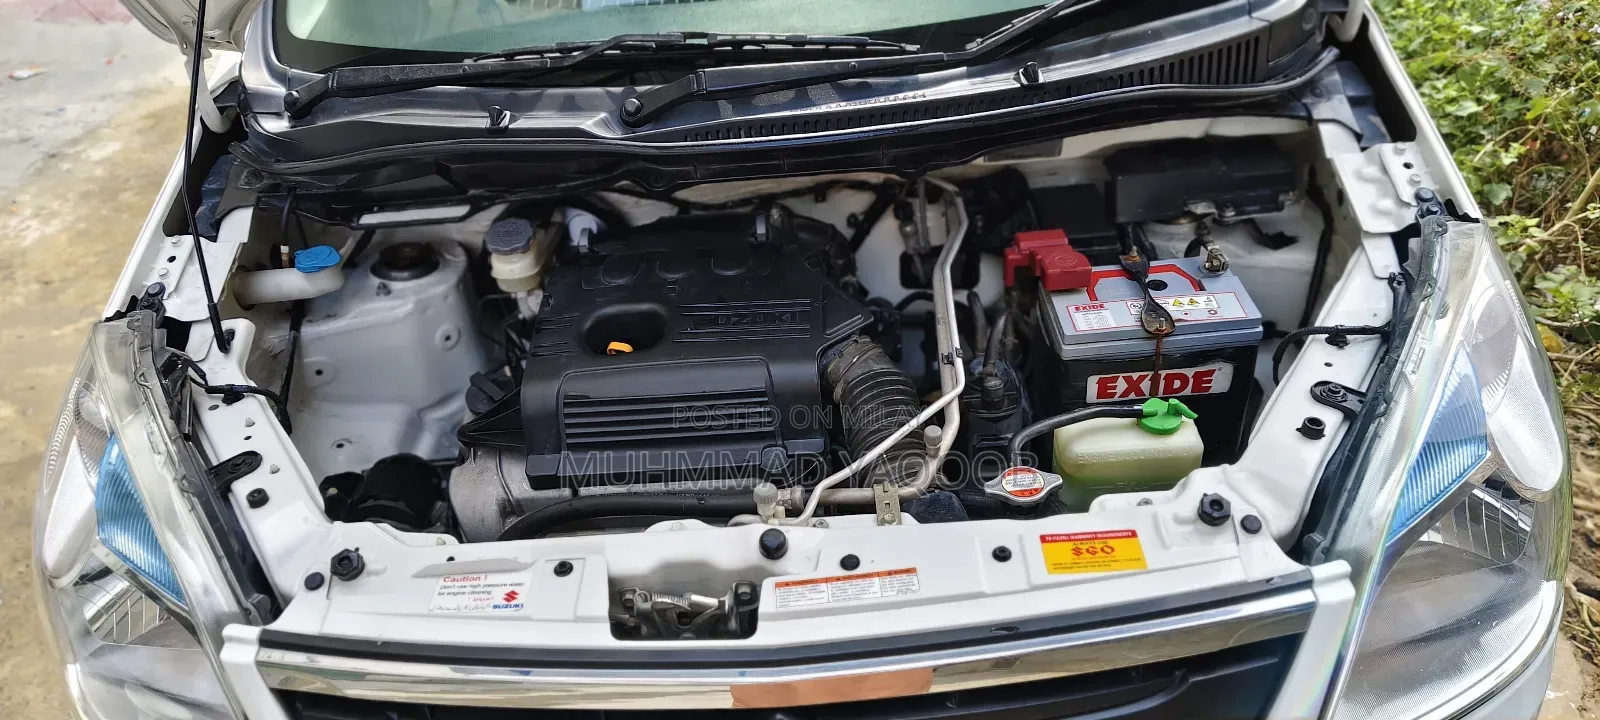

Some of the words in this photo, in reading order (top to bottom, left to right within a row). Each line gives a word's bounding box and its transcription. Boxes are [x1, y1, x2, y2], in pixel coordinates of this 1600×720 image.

[1074, 303, 1105, 312] EXIDE
[1096, 368, 1217, 400] EXIDE
[1077, 450, 1115, 465] ENGINE
[1070, 544, 1115, 557] SGO
[443, 575, 481, 583] Caution
